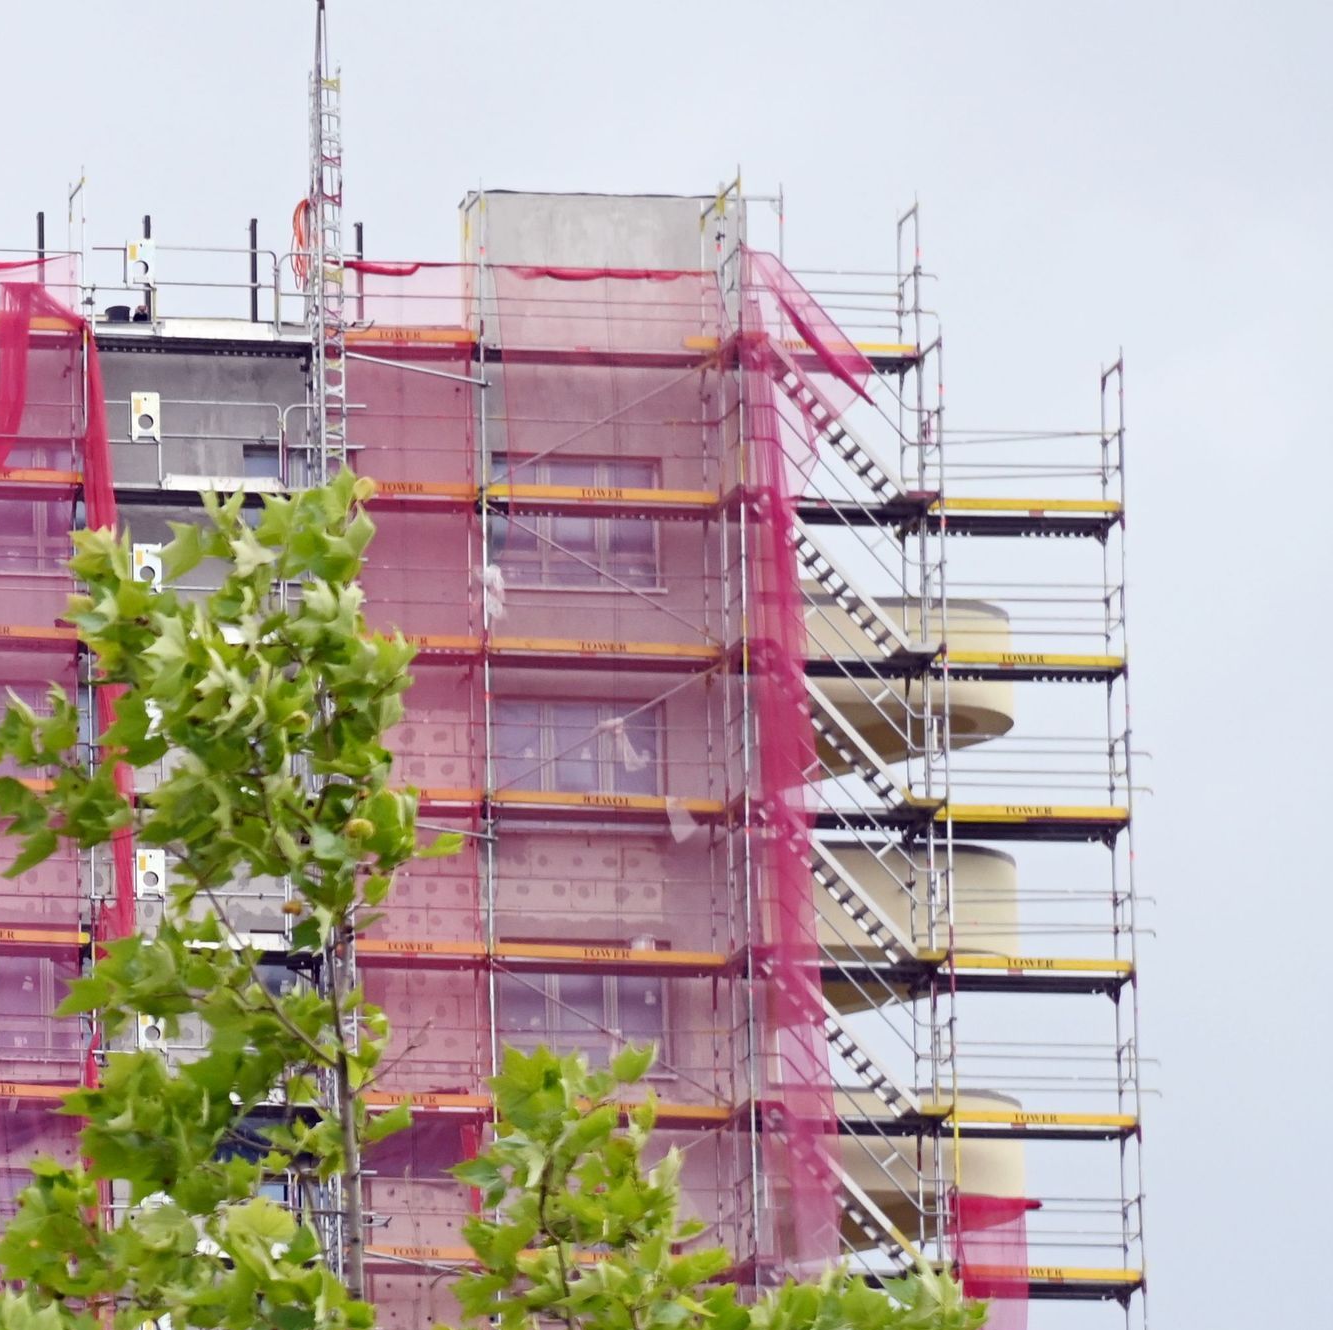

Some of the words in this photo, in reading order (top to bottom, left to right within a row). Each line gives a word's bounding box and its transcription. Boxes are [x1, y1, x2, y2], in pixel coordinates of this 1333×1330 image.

[378, 330, 421, 340] TOWER
[381, 483, 424, 492] TOWER
[582, 488, 623, 499] TOWER
[579, 641, 626, 652] TOWER
[1000, 654, 1044, 664] TOWER
[583, 796, 629, 806] TOWER
[1005, 806, 1052, 815] TOWER
[386, 942, 434, 952] TOWER
[583, 948, 630, 959] TOWER
[1007, 959, 1054, 969] TOWER
[1014, 1113, 1058, 1123] TOWER
